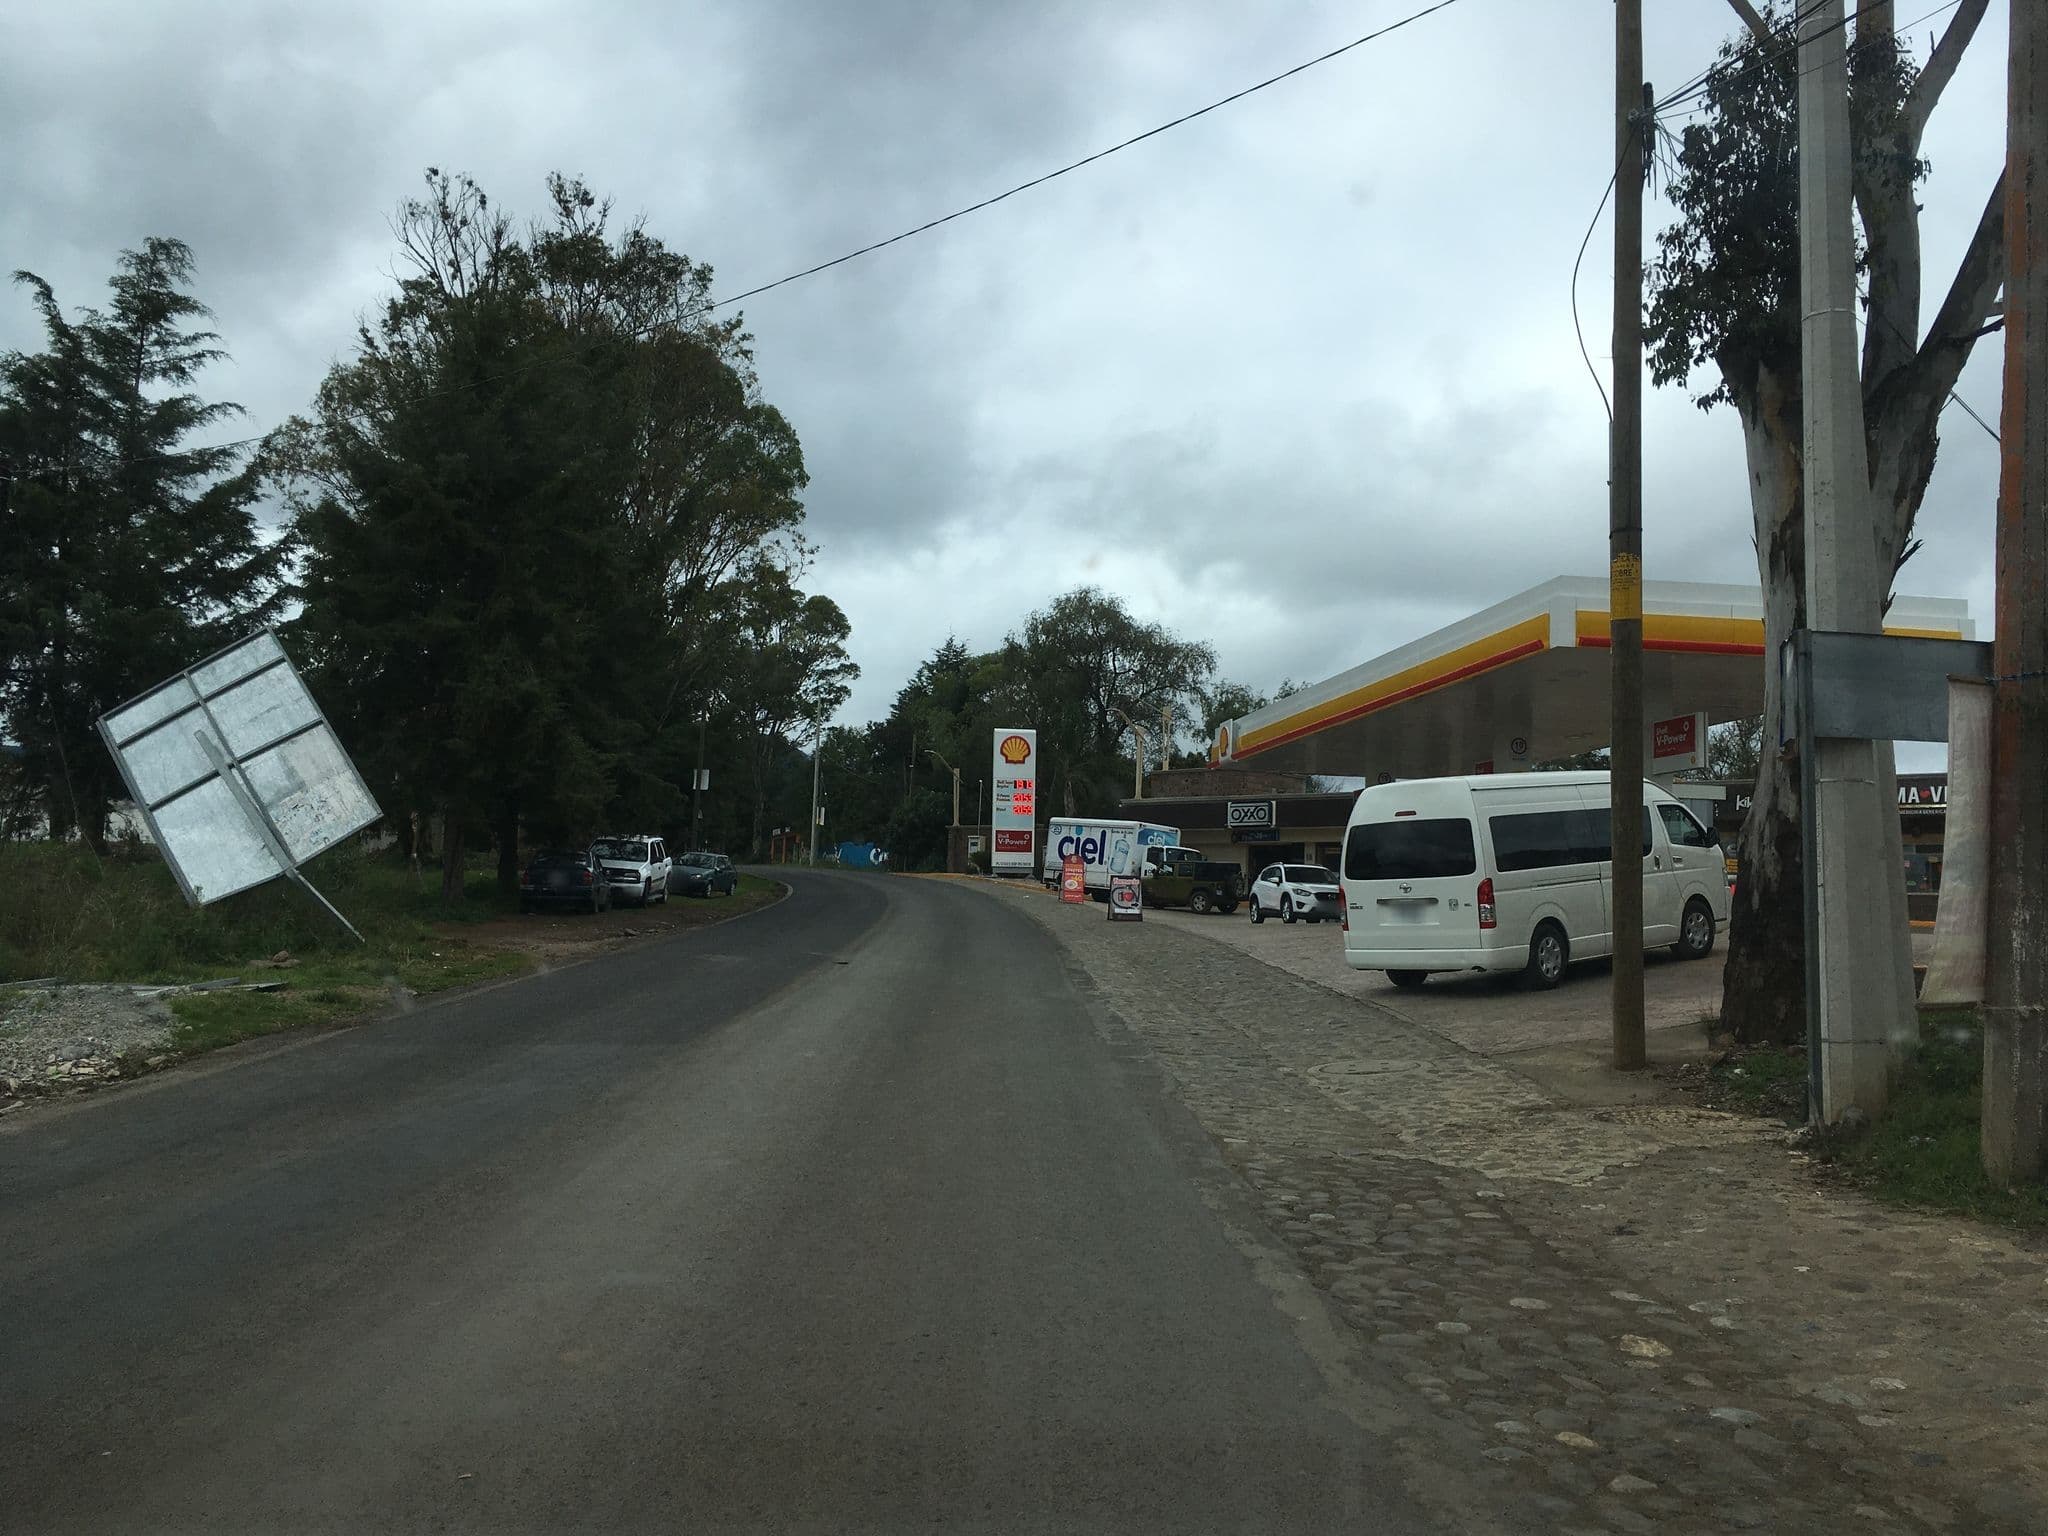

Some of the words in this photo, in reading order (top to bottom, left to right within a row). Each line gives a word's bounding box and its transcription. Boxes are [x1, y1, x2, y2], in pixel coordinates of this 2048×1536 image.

[1656, 734, 1687, 746] V-Power
[1232, 806, 1267, 822] OXXO
[1058, 825, 1107, 865] ciel
[1147, 832, 1166, 845] ciel
